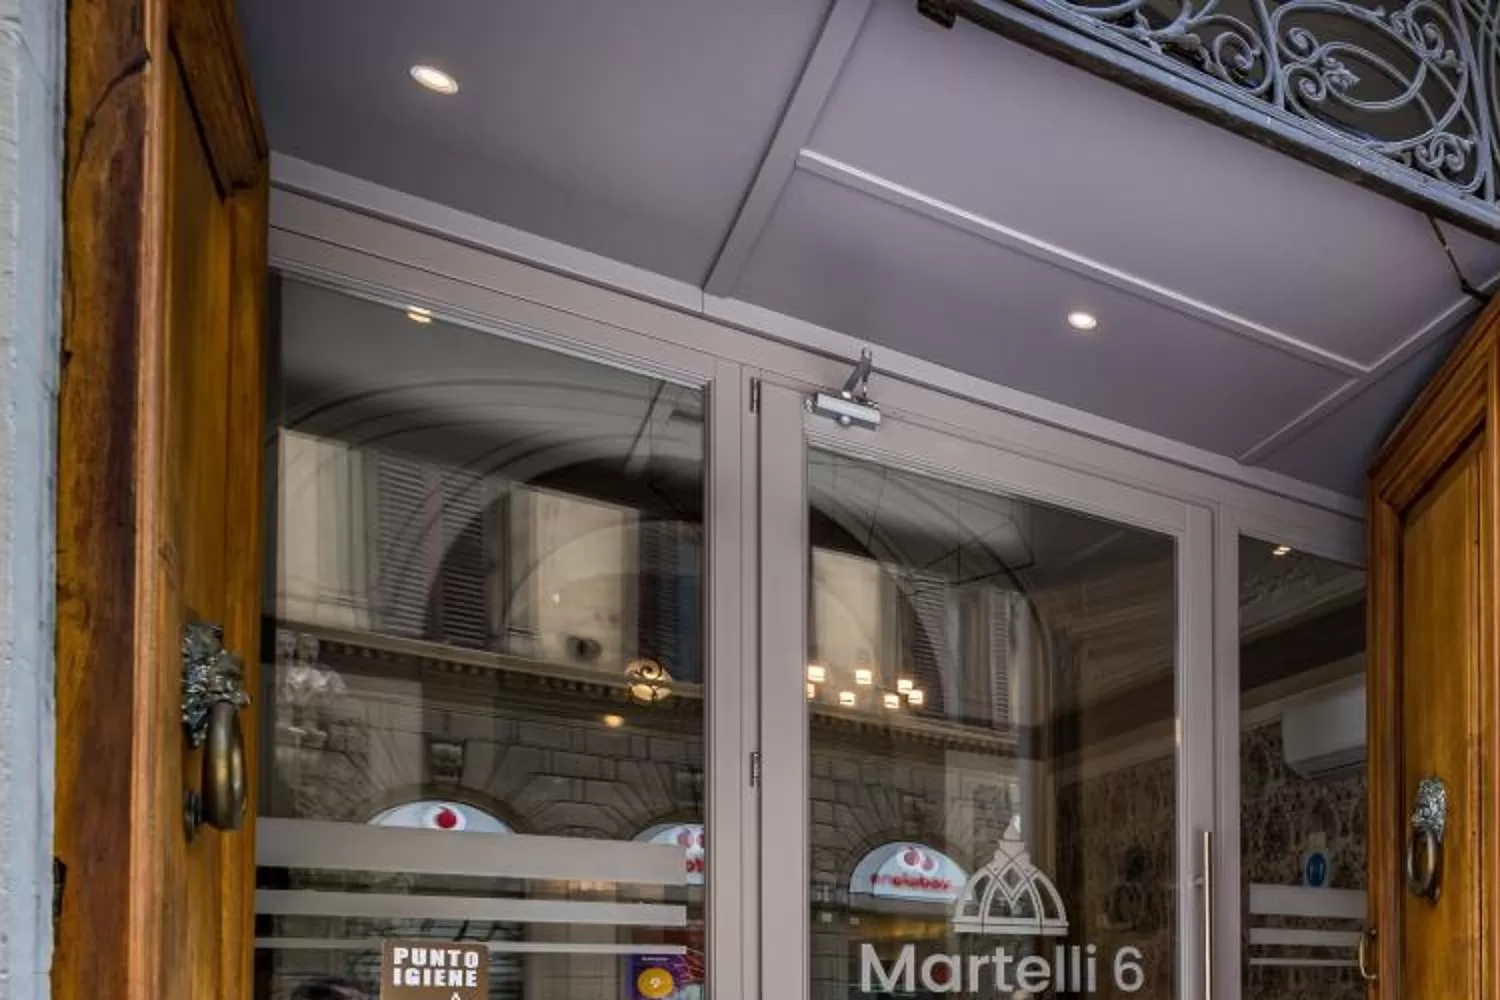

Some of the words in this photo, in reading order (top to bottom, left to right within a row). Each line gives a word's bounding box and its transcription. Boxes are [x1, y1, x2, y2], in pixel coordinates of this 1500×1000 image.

[393, 947, 479, 968] PUNTO
[861, 943, 1097, 993] Martelli
[1113, 946, 1145, 992] 6
[393, 967, 477, 987] IGIENE
